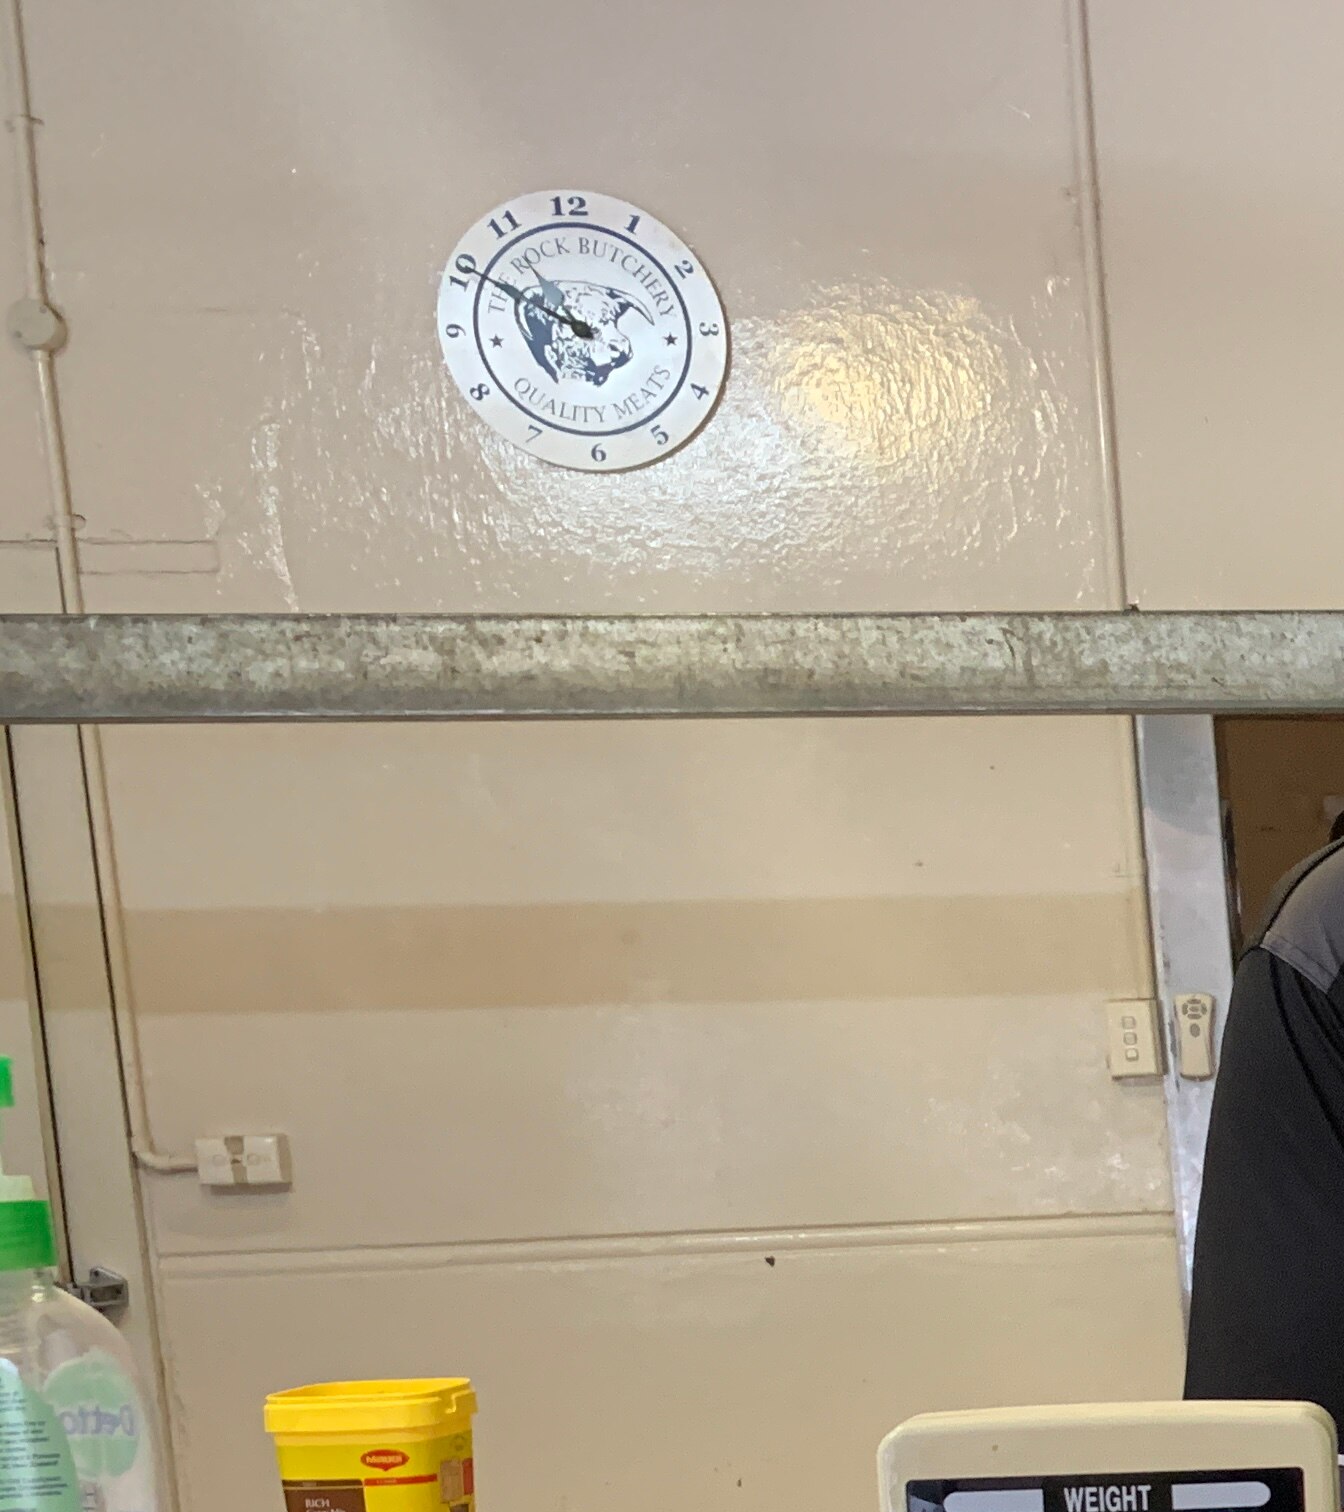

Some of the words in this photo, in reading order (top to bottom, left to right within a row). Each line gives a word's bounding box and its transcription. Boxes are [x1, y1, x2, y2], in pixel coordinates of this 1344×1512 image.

[550, 196, 588, 217] 12
[487, 211, 522, 239] 11
[624, 214, 641, 234] 1
[449, 254, 477, 292] 10
[488, 273, 517, 314] THE
[510, 238, 570, 275] ROCK
[579, 237, 677, 318] BUTCHERY
[674, 259, 693, 279] 2
[446, 324, 466, 338] 9
[700, 322, 719, 337] 3
[470, 383, 490, 400] 8
[514, 377, 607, 423] QUALITY
[613, 366, 670, 419] MEATS
[690, 382, 710, 400] 4
[526, 425, 543, 443] 7
[651, 425, 669, 445] 5
[591, 443, 607, 462] 6
[305, 1498, 330, 1508] RICH
